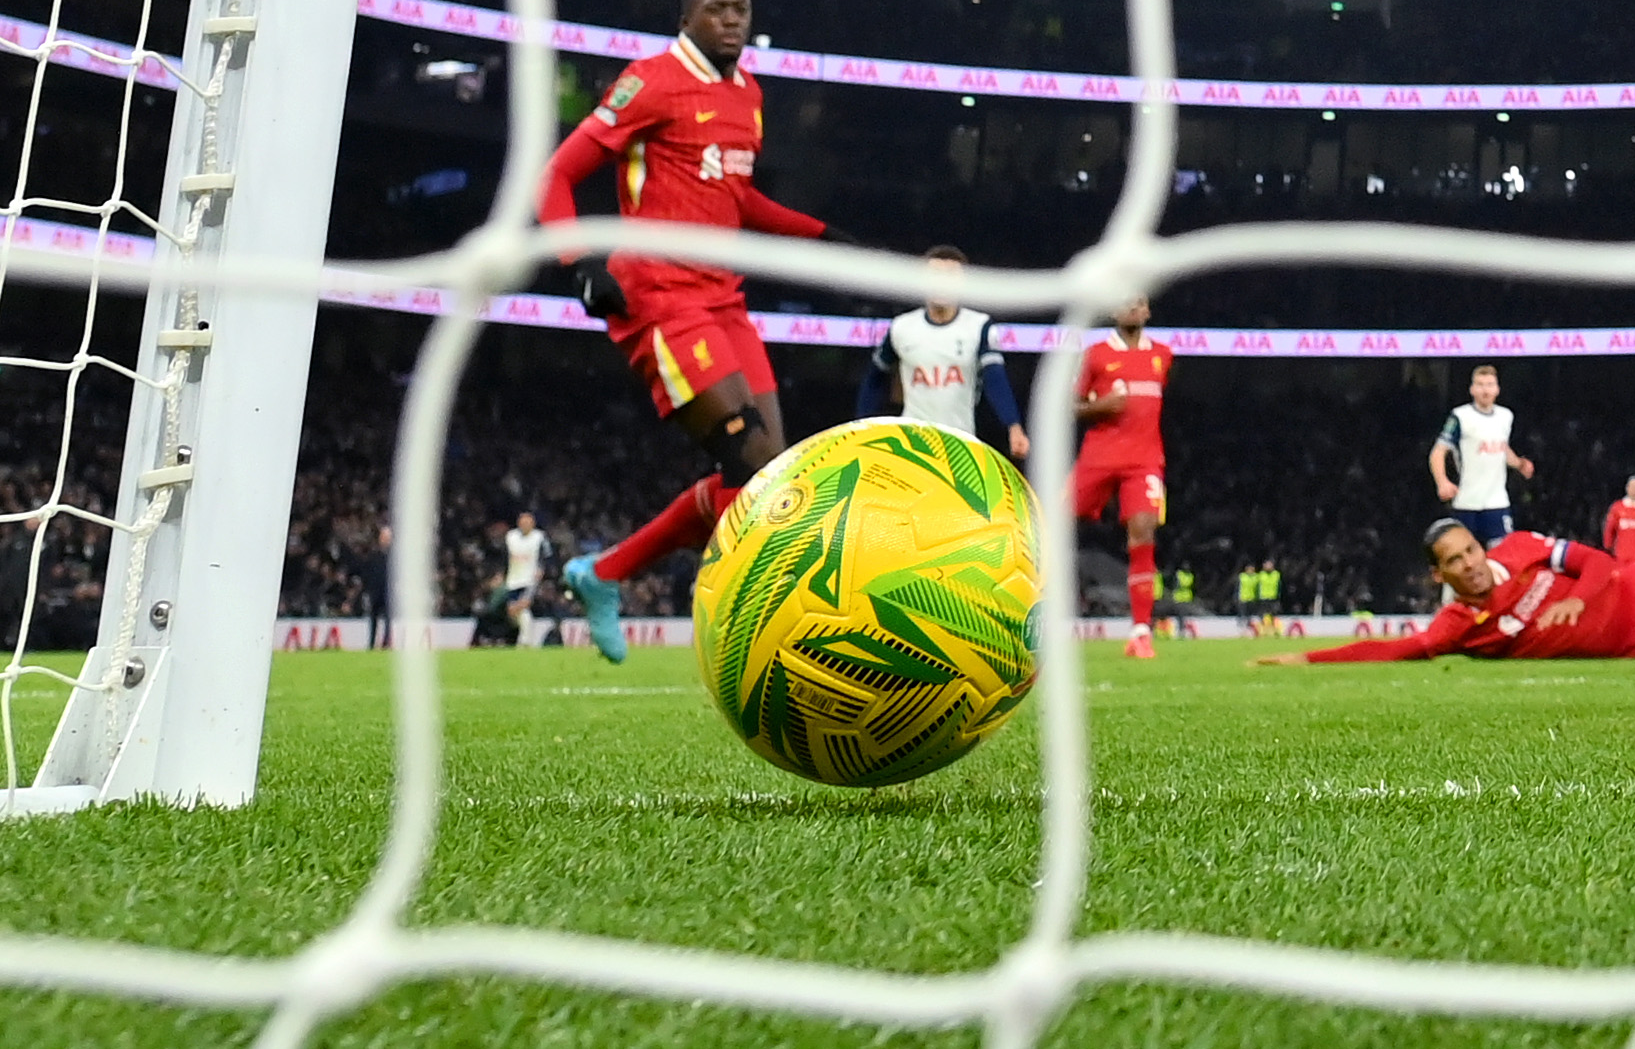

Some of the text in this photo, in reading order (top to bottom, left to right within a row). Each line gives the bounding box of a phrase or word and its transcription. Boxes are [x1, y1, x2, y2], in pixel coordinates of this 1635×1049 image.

[781, 54, 815, 73] AIA
[841, 59, 878, 80] AIA
[901, 65, 938, 84] AIA
[961, 70, 998, 88] AIA
[1022, 75, 1059, 92] AIA
[1082, 79, 1119, 96] AIA
[1204, 85, 1240, 101] AIA
[1264, 86, 1301, 103] AIA
[1325, 88, 1361, 104] AIA
[1385, 88, 1422, 104] AIA
[1445, 88, 1480, 104] AIA
[1504, 88, 1540, 104] AIA
[1563, 88, 1599, 103] AIA
[1171, 332, 1209, 349] AIA
[1234, 333, 1272, 350] AIA
[1297, 333, 1335, 350] AIA
[1361, 334, 1400, 350] AIA
[1424, 334, 1462, 350] AIA
[1486, 333, 1525, 350] AIA
[1548, 332, 1586, 349] AIA
[911, 364, 965, 388] AIA
[284, 626, 342, 649] AIA
